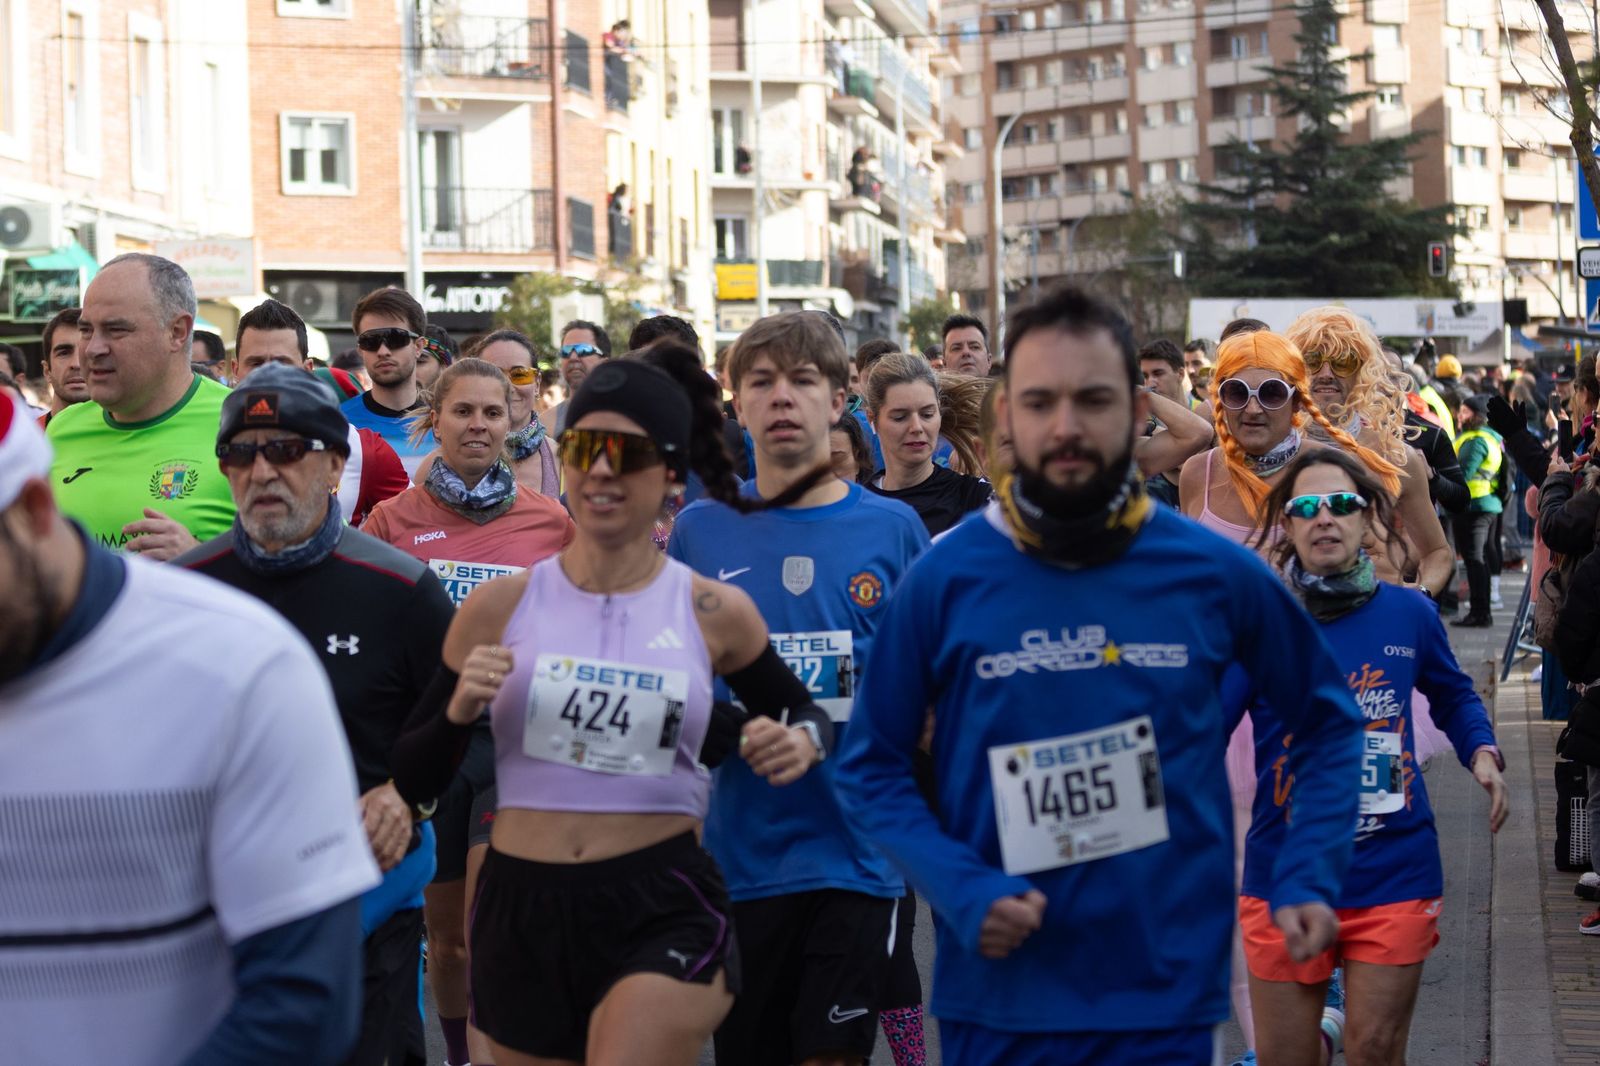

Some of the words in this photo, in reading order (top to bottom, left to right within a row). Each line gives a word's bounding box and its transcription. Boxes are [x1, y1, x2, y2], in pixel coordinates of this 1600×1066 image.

[414, 530, 447, 545] HOKA
[456, 566, 512, 580] SETE
[1020, 624, 1106, 651] CLUB
[1384, 644, 1416, 659] OYSH
[560, 687, 631, 736] 424
[1033, 732, 1137, 768] SETEL
[1023, 763, 1118, 827] 1465
